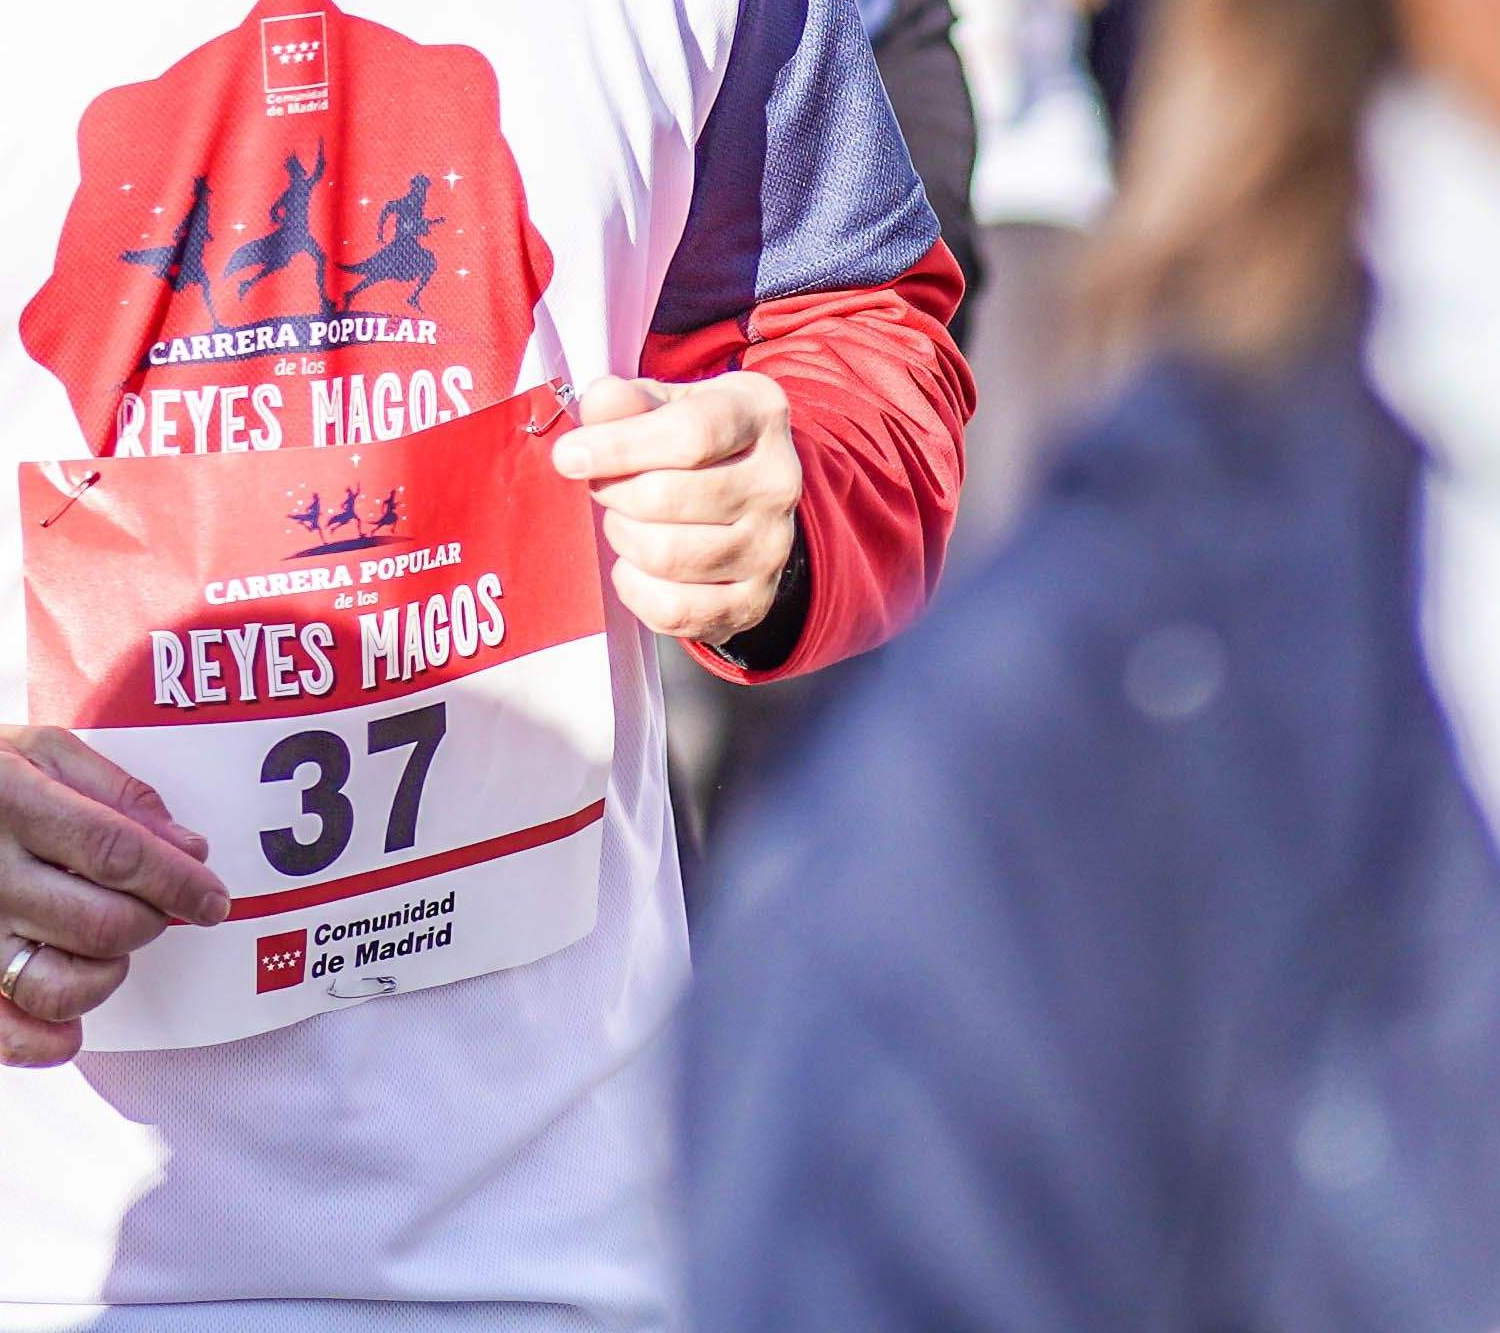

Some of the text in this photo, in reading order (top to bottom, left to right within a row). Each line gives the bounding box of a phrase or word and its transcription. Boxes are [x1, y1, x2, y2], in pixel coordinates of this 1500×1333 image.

[287, 99, 329, 114] Madrid
[149, 318, 438, 366] CARRERA POPULAR
[274, 357, 326, 376] de los
[115, 365, 474, 457] REYES MAGOS
[205, 542, 462, 605] CARRERA POPULAR
[334, 590, 379, 611] de los
[150, 572, 505, 708] REYES MAGOS
[259, 701, 447, 876] 37
[313, 890, 455, 946] Comunidad
[311, 922, 452, 979] de Madrid
